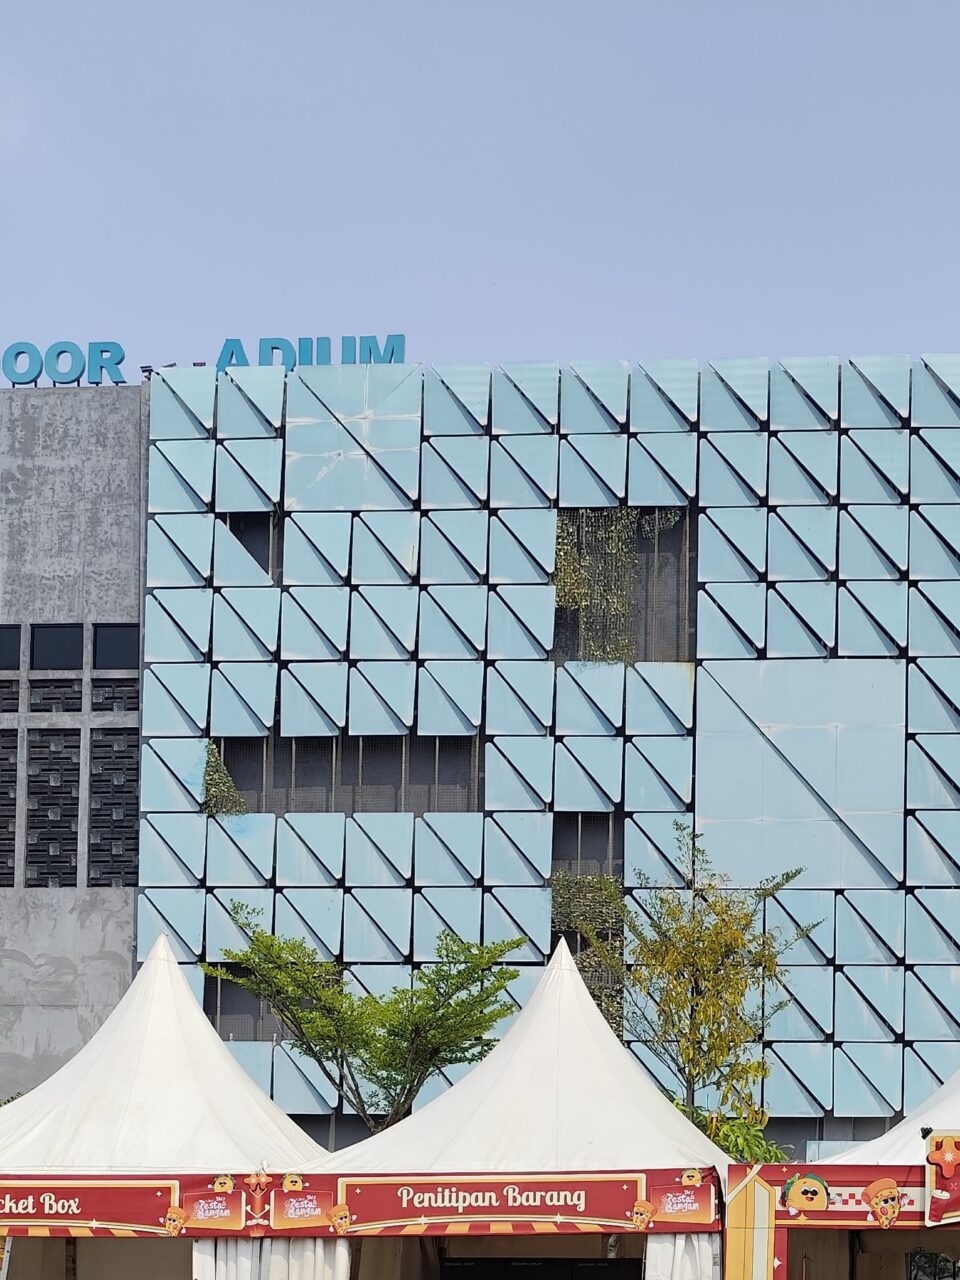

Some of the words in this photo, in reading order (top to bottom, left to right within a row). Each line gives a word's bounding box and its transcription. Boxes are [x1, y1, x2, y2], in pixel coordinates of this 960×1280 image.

[2, 341, 126, 385] OOR
[40, 1192, 82, 1214] Box
[397, 1186, 500, 1213] Penitipan
[503, 1184, 586, 1212] Barang
